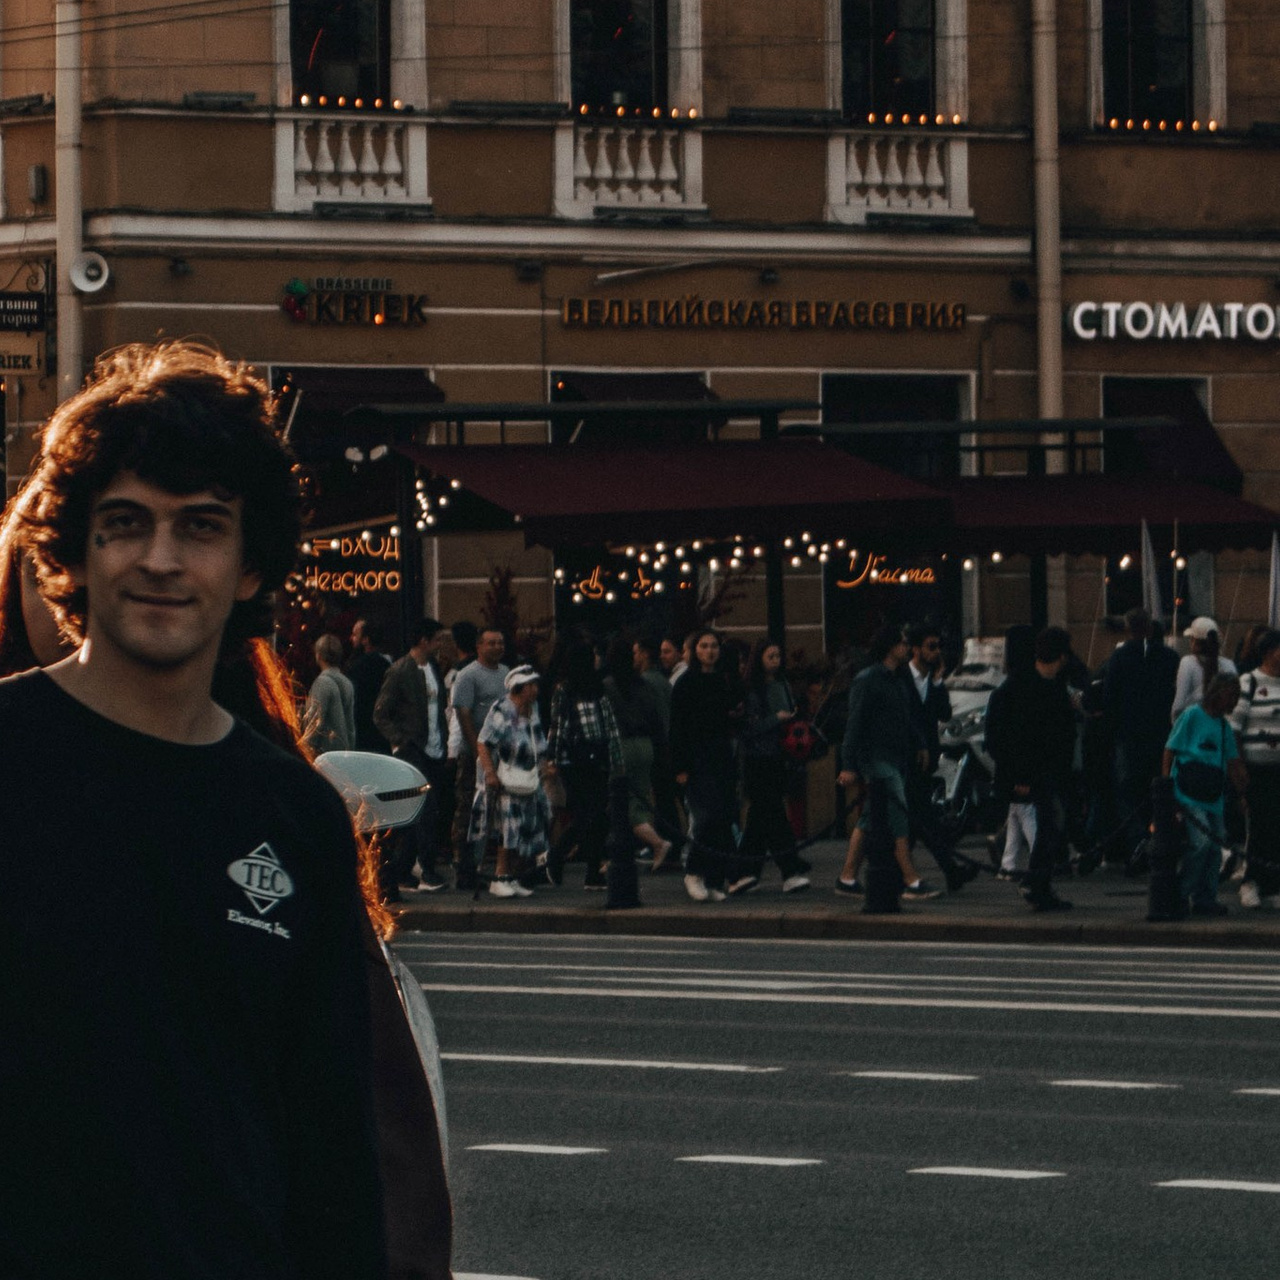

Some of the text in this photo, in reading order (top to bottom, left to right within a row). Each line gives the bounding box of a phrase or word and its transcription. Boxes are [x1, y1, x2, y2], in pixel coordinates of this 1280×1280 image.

[312, 292, 429, 327] KRIEK
[1072, 300, 1280, 340] СТОМАТО
[242, 862, 285, 894] TEC
